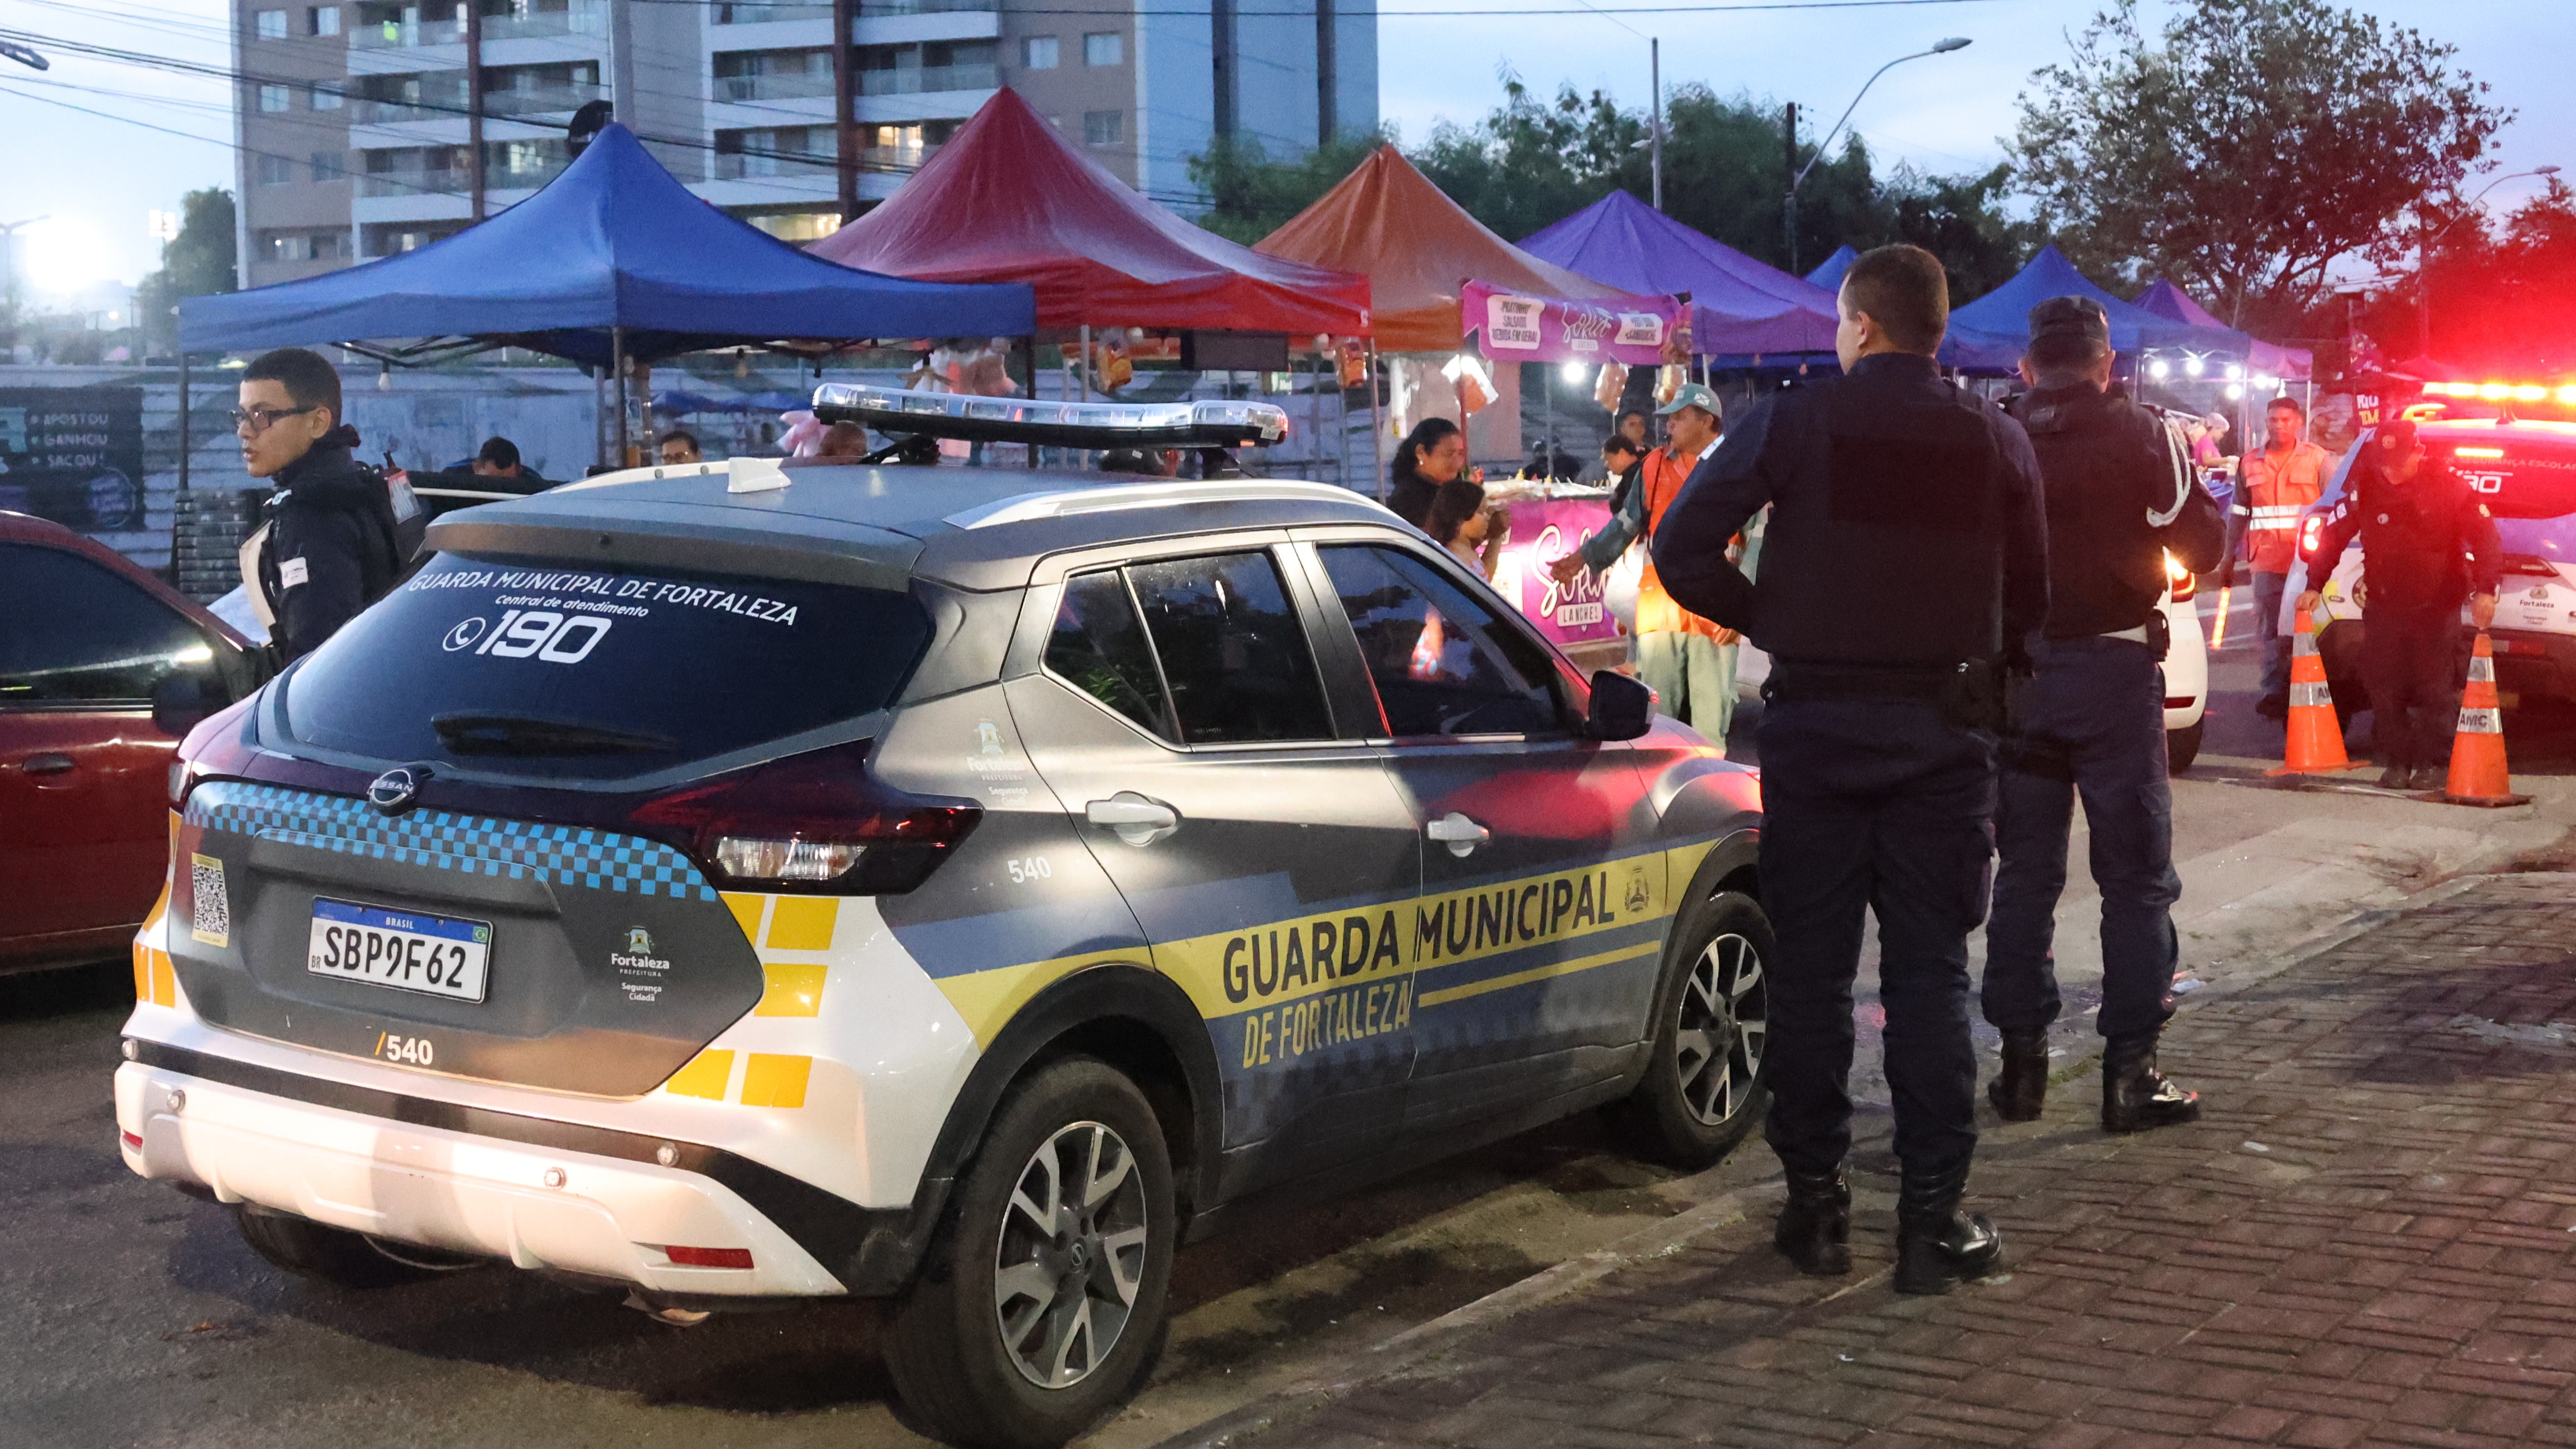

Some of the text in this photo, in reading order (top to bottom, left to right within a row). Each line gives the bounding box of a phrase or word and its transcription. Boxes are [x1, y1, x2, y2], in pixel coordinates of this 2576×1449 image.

[44, 414, 108, 425] APOSTOU
[44, 434, 108, 447] GANHOU
[409, 572, 798, 626] GUARDA MUNICIPAL DE FORTALEZA
[2520, 599, 2554, 608] Fortaleza
[543, 597, 561, 607] de
[563, 599, 649, 617] atendimento
[1563, 606, 1598, 623] LANCHES
[474, 610, 612, 664] 190
[2460, 713, 2487, 728] AMC
[988, 787, 1029, 797] Segurança
[1008, 856, 1052, 883] 540
[385, 917, 414, 930] BRASIL
[1223, 871, 1615, 1003] GUARDA MUNICIPAL
[311, 955, 320, 969] BR
[324, 927, 466, 988] SBP9F62
[611, 953, 670, 969] Fortaleza
[620, 969, 661, 977] PREFEITURA
[621, 982, 662, 994] Segurança
[629, 992, 655, 1001] Cidadã
[1243, 980, 1410, 1069] DE FORTALEZA
